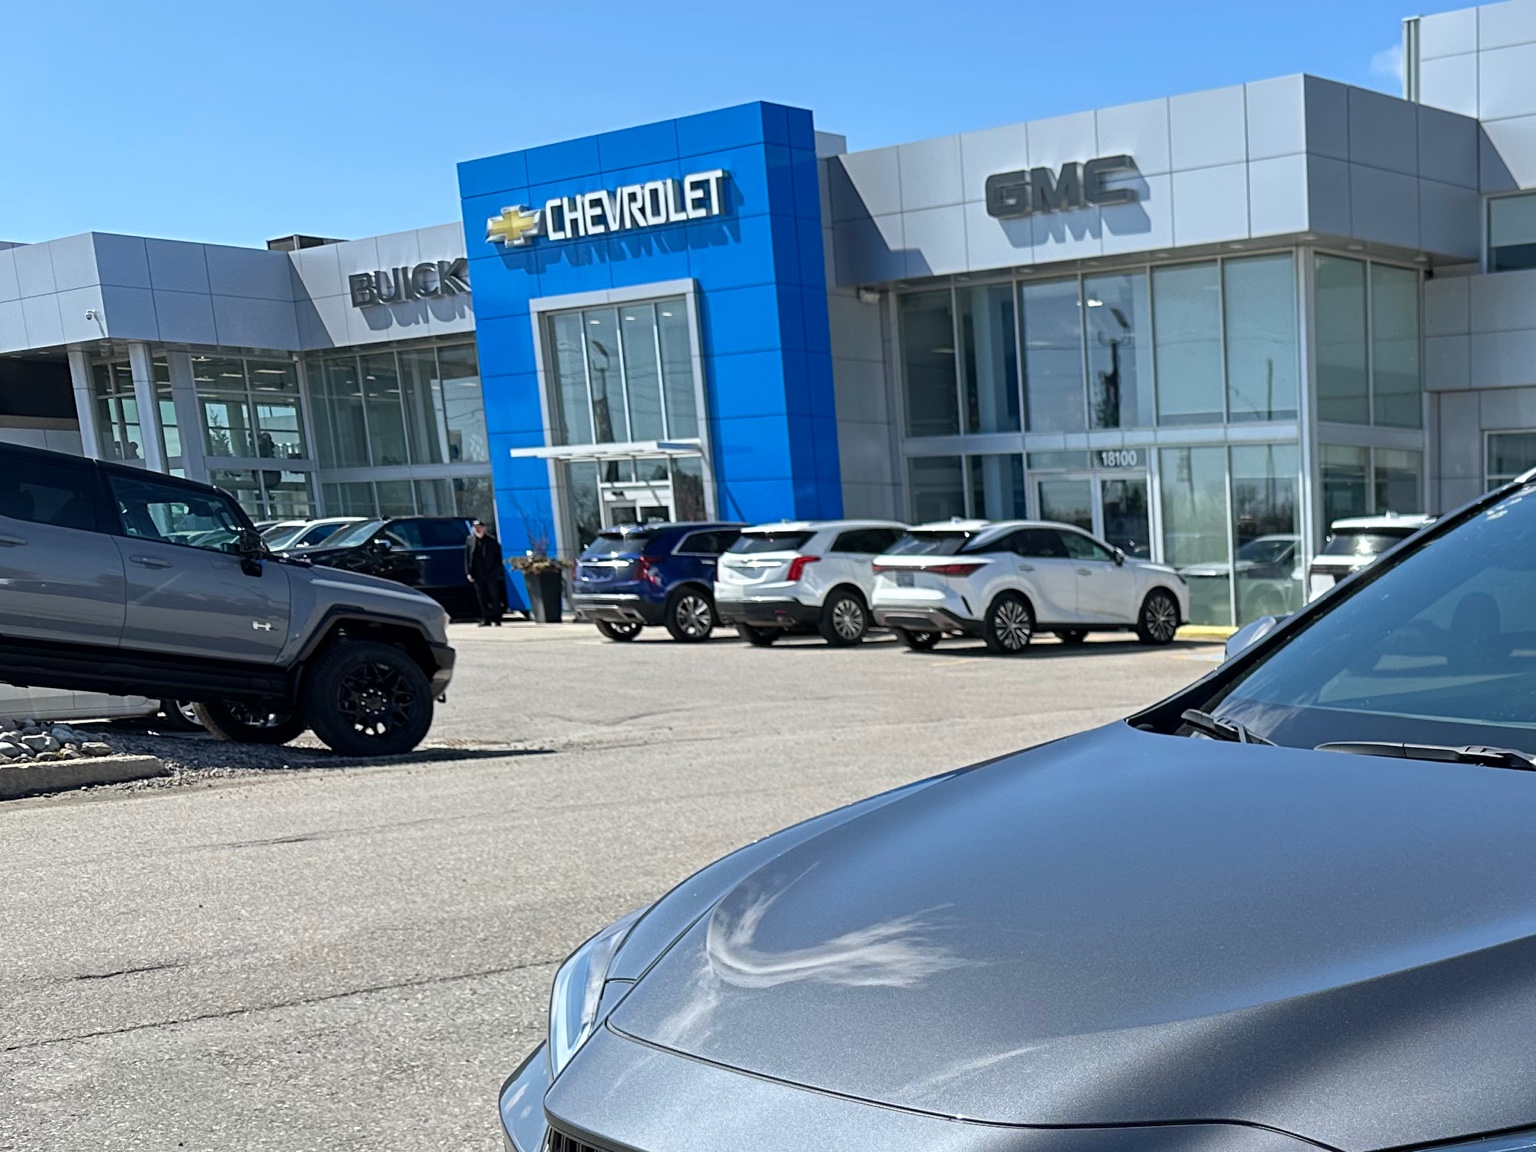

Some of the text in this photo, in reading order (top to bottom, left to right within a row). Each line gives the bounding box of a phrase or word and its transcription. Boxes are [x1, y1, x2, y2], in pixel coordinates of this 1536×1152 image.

[544, 169, 724, 241] CHEVROLET
[985, 154, 1136, 220] GMC
[348, 257, 472, 309] BUICK
[1102, 450, 1138, 467] 18100
